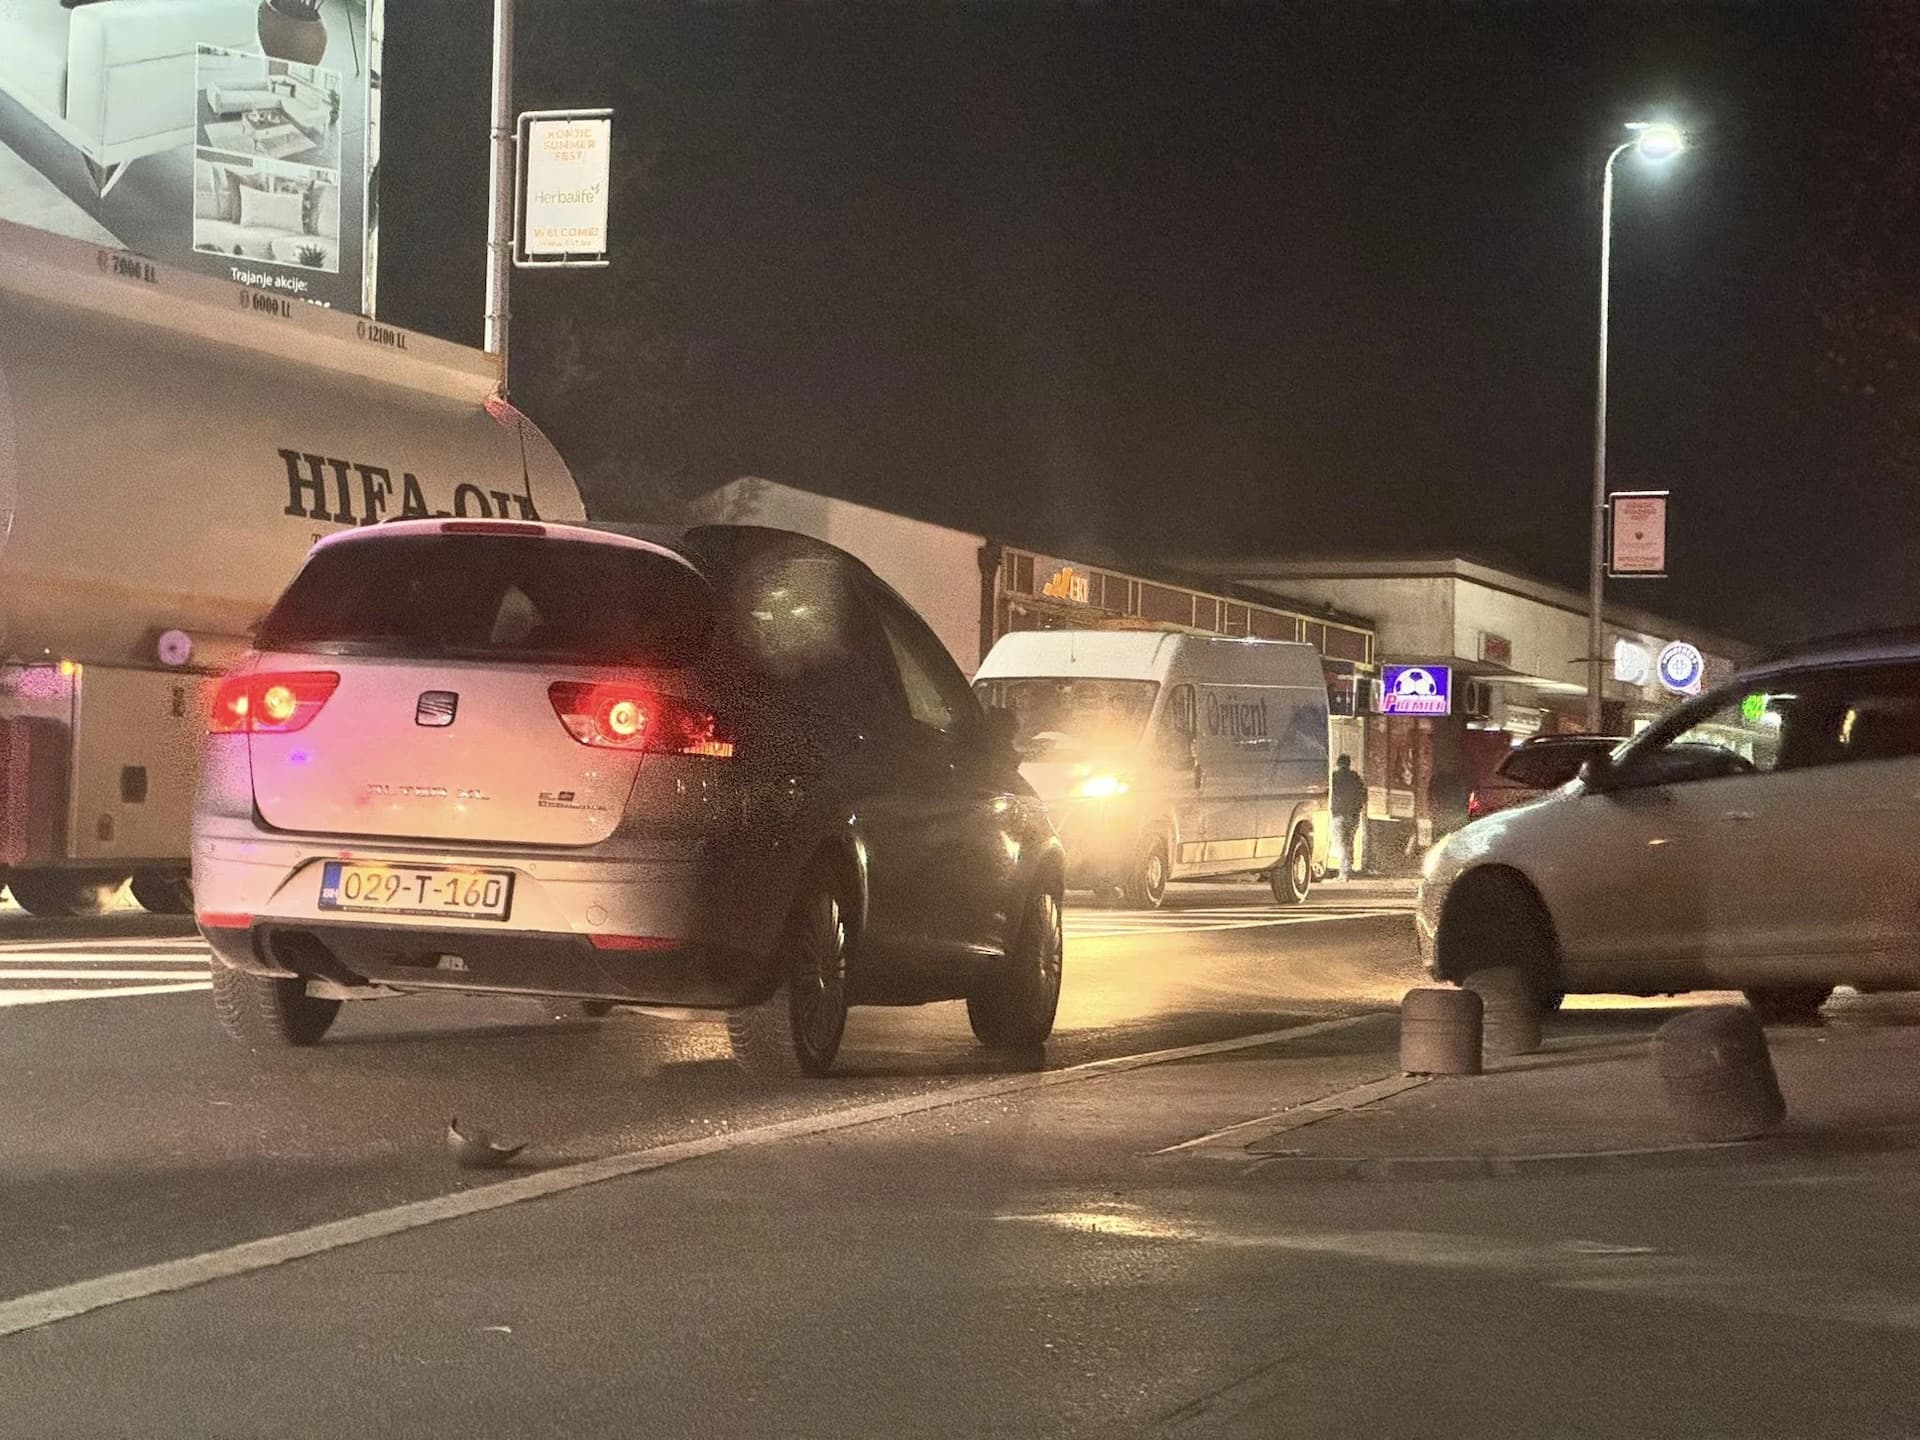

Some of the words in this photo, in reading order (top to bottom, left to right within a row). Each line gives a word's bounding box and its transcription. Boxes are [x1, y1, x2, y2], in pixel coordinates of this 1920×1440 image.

[544, 139, 596, 150] SUMMER
[535, 189, 594, 204] Herbalife
[533, 227, 599, 238] WELCOME!
[231, 268, 273, 288] Trajanje
[274, 275, 308, 293] akcije:
[253, 293, 279, 316] 6000
[368, 325, 394, 347] 12100
[344, 872, 501, 908] 029-T-160
